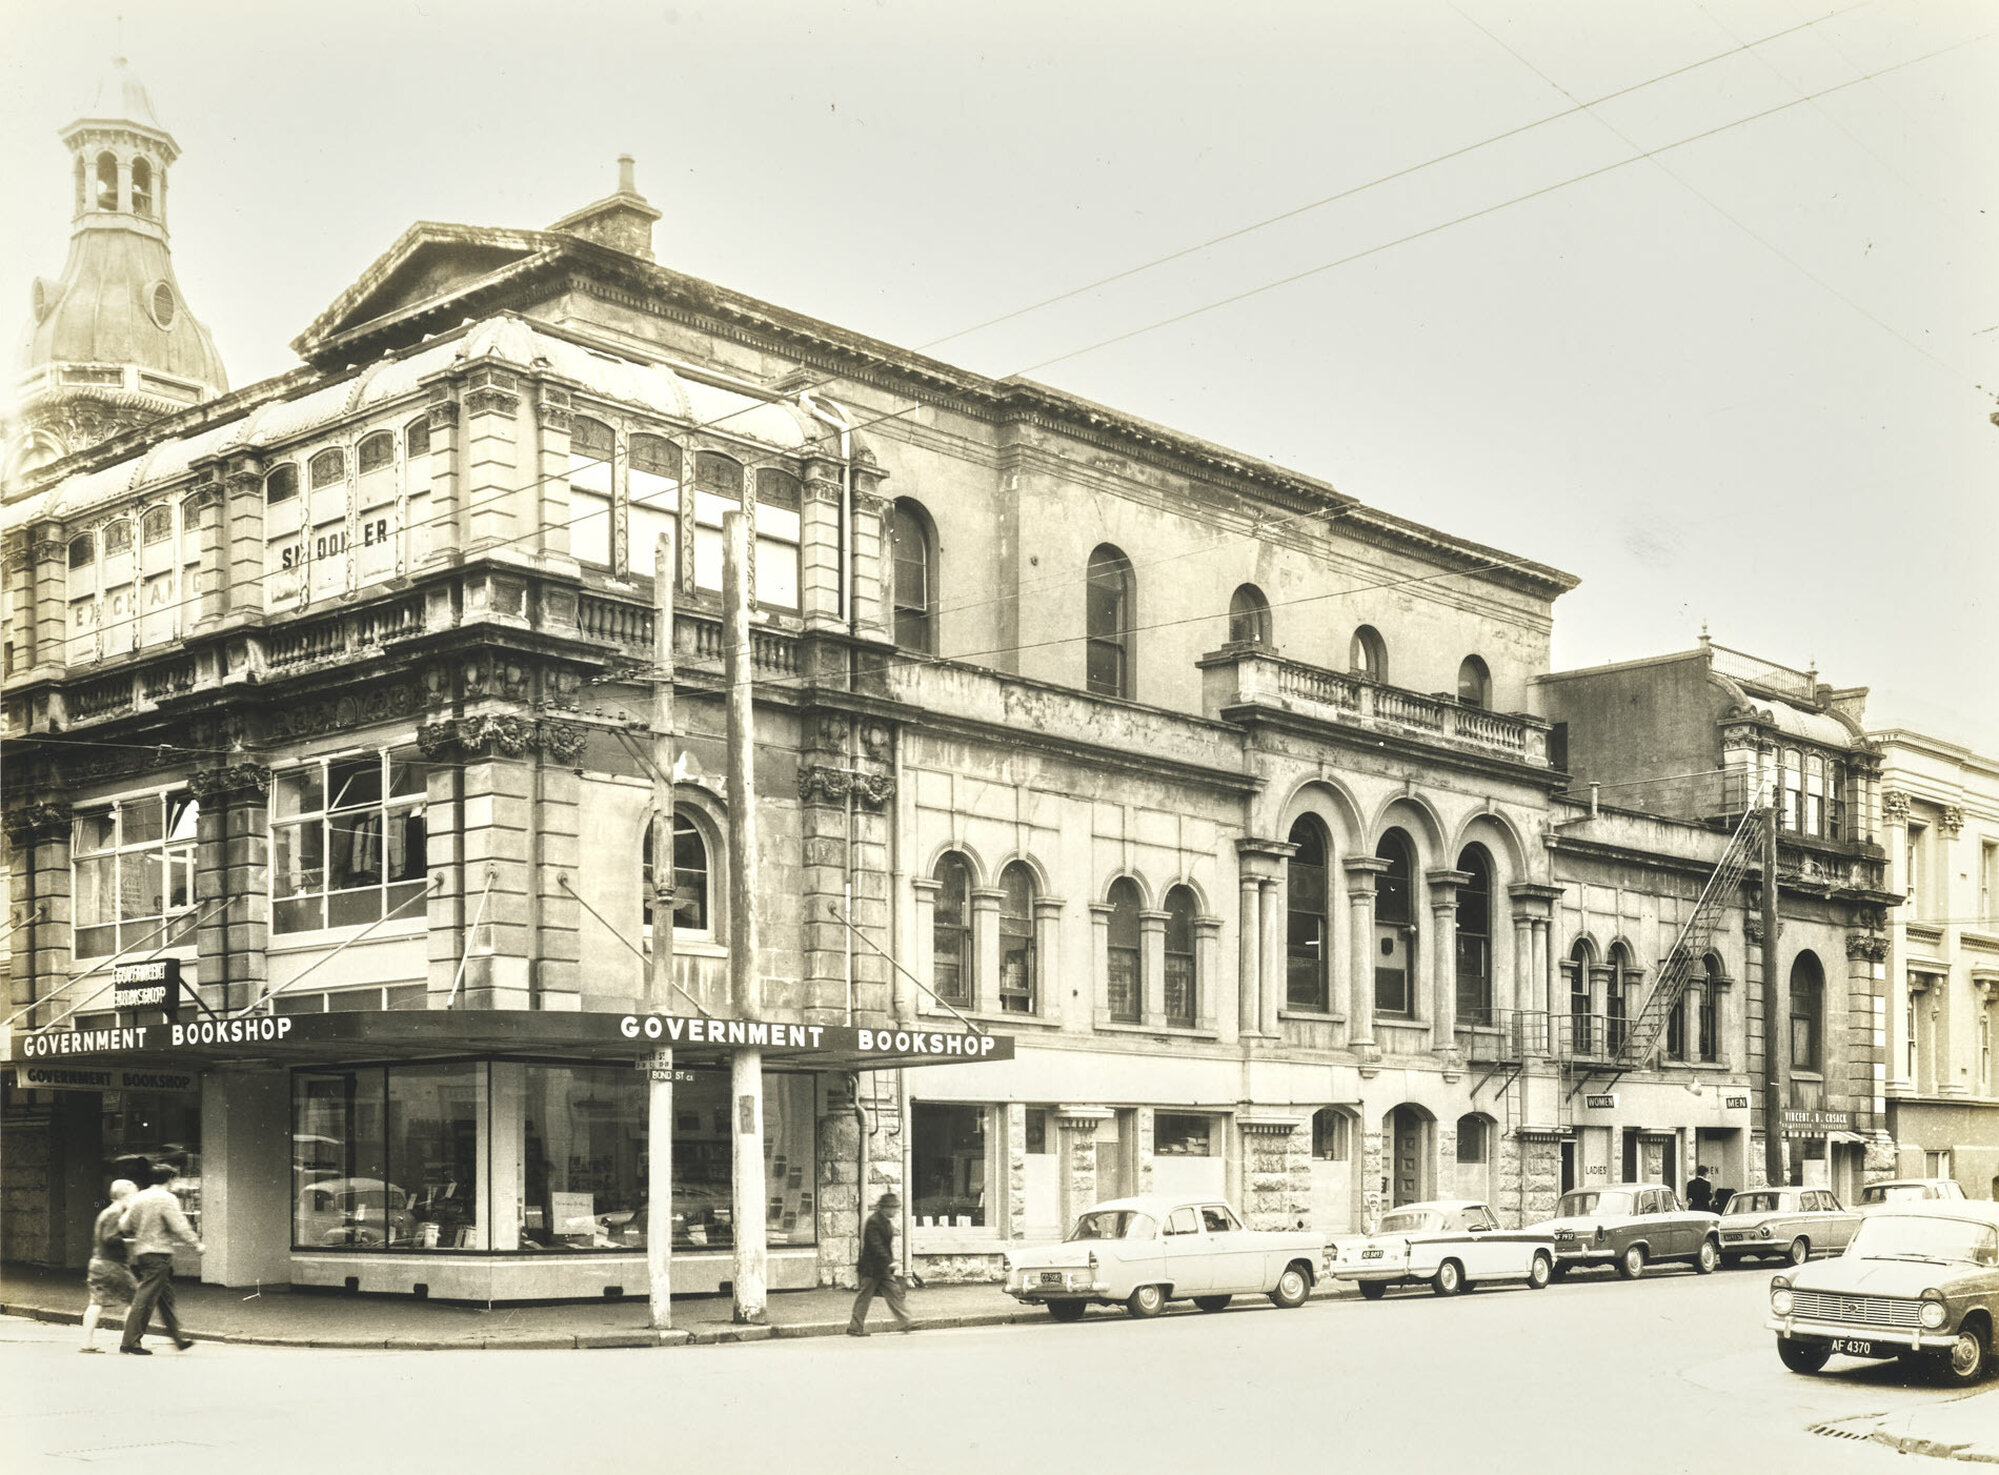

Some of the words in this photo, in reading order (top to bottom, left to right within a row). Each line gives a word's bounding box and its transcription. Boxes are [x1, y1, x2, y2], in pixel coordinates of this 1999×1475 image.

[24, 1027, 147, 1057] GOVERNMENT
[172, 1017, 292, 1046] BOOKSHOP
[620, 1015, 824, 1048] GOVERNMENT
[858, 1029, 996, 1056] BOOKSHOP
[27, 1068, 112, 1086] GOVERNMENT
[122, 1071, 191, 1089] BOOKSHOP
[652, 1070, 672, 1080] BOND
[1587, 1097, 1614, 1108] WOMEN
[1727, 1097, 1747, 1108] MEN
[1585, 1165, 1608, 1175] LADIES
[1832, 1340, 1846, 1351] AF
[1847, 1340, 1871, 1354] 4370
